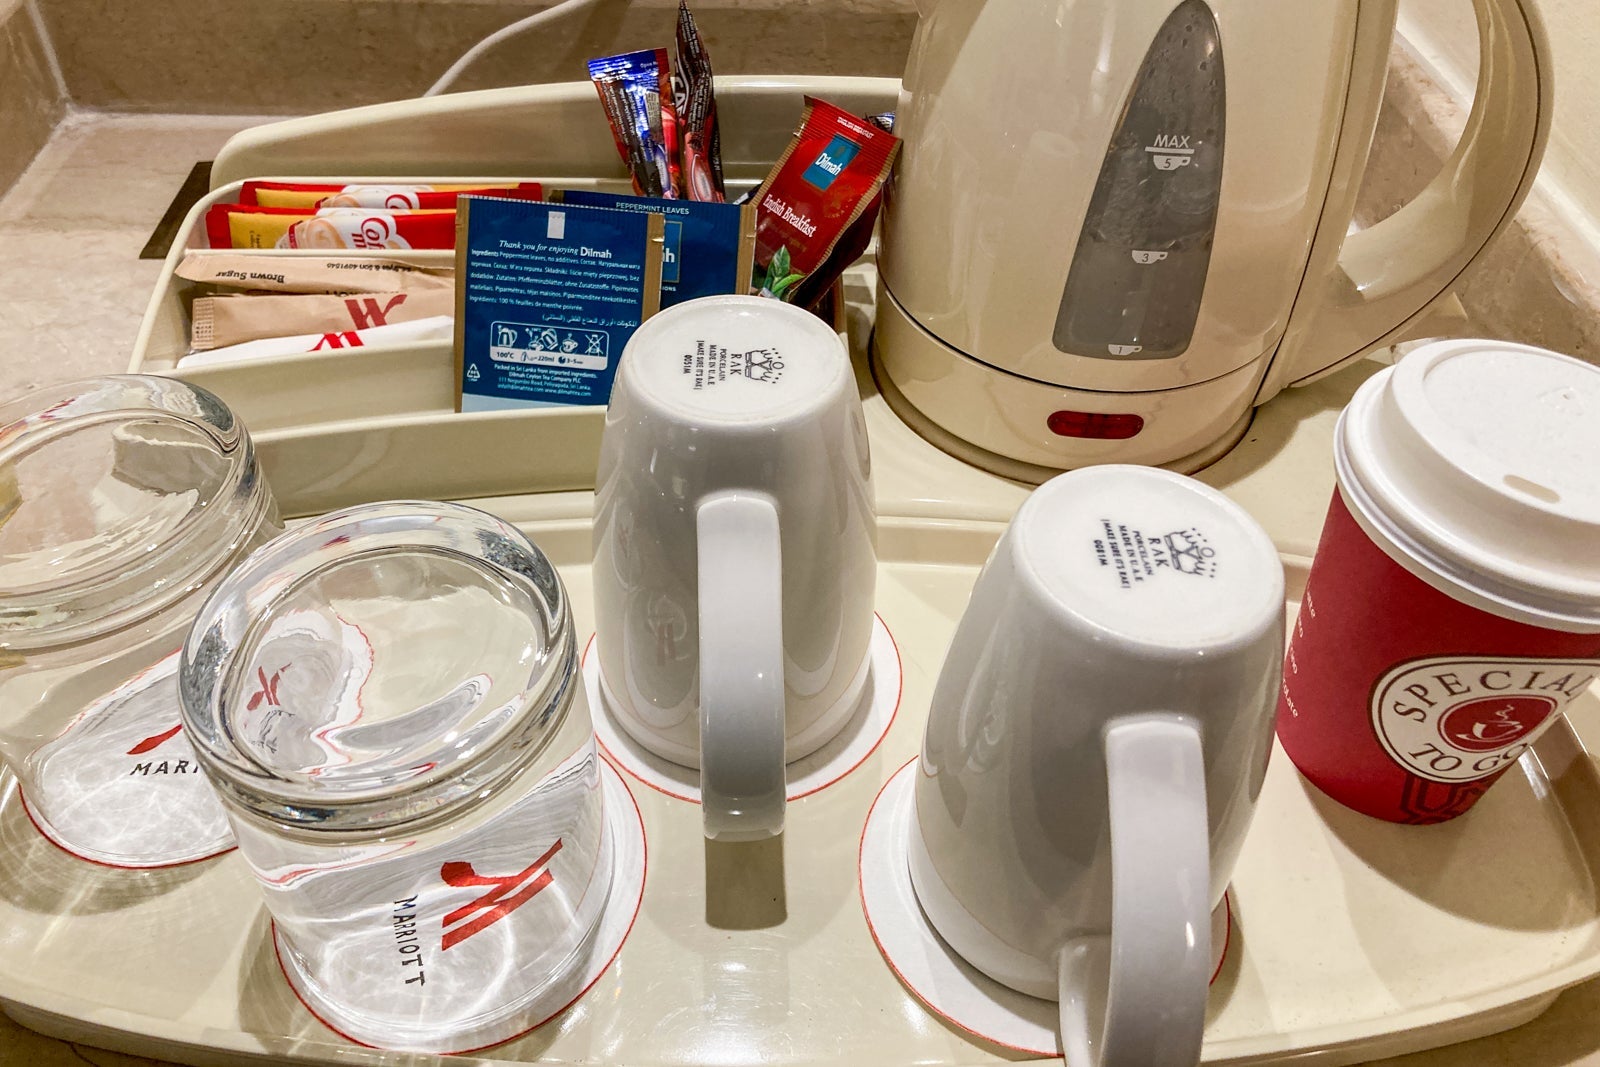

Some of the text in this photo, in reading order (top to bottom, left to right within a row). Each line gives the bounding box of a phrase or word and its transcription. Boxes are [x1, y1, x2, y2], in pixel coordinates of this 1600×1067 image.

[1154, 134, 1190, 148] MAX
[815, 152, 844, 176] Dilmah
[1163, 158, 1172, 168] 5
[616, 202, 690, 215] PEPPERMINT LEAVES
[763, 194, 818, 238] English Breakfast
[471, 249, 499, 257] Ingredients
[499, 240, 521, 249] Thank
[536, 244, 547, 252] for
[548, 246, 578, 255] enjoying
[580, 246, 612, 258] Dilmah
[1142, 254, 1149, 262] 3
[216, 270, 285, 283] Brown Sugar
[709, 344, 717, 360] MADE
[696, 356, 704, 368] SURE
[719, 348, 727, 381] PORCELAIN
[730, 354, 742, 375] RAK
[549, 369, 570, 377] imported
[571, 370, 597, 378] ingredients.
[551, 375, 572, 383] Company
[1118, 525, 1132, 547] MADE
[1126, 549, 1135, 557] IN
[1109, 542, 1121, 557] SURE
[1132, 530, 1154, 575] PORCELAIN
[1148, 538, 1169, 567] RAK
[1408, 743, 1462, 772] TO
[393, 894, 426, 986] MARRIOTT
